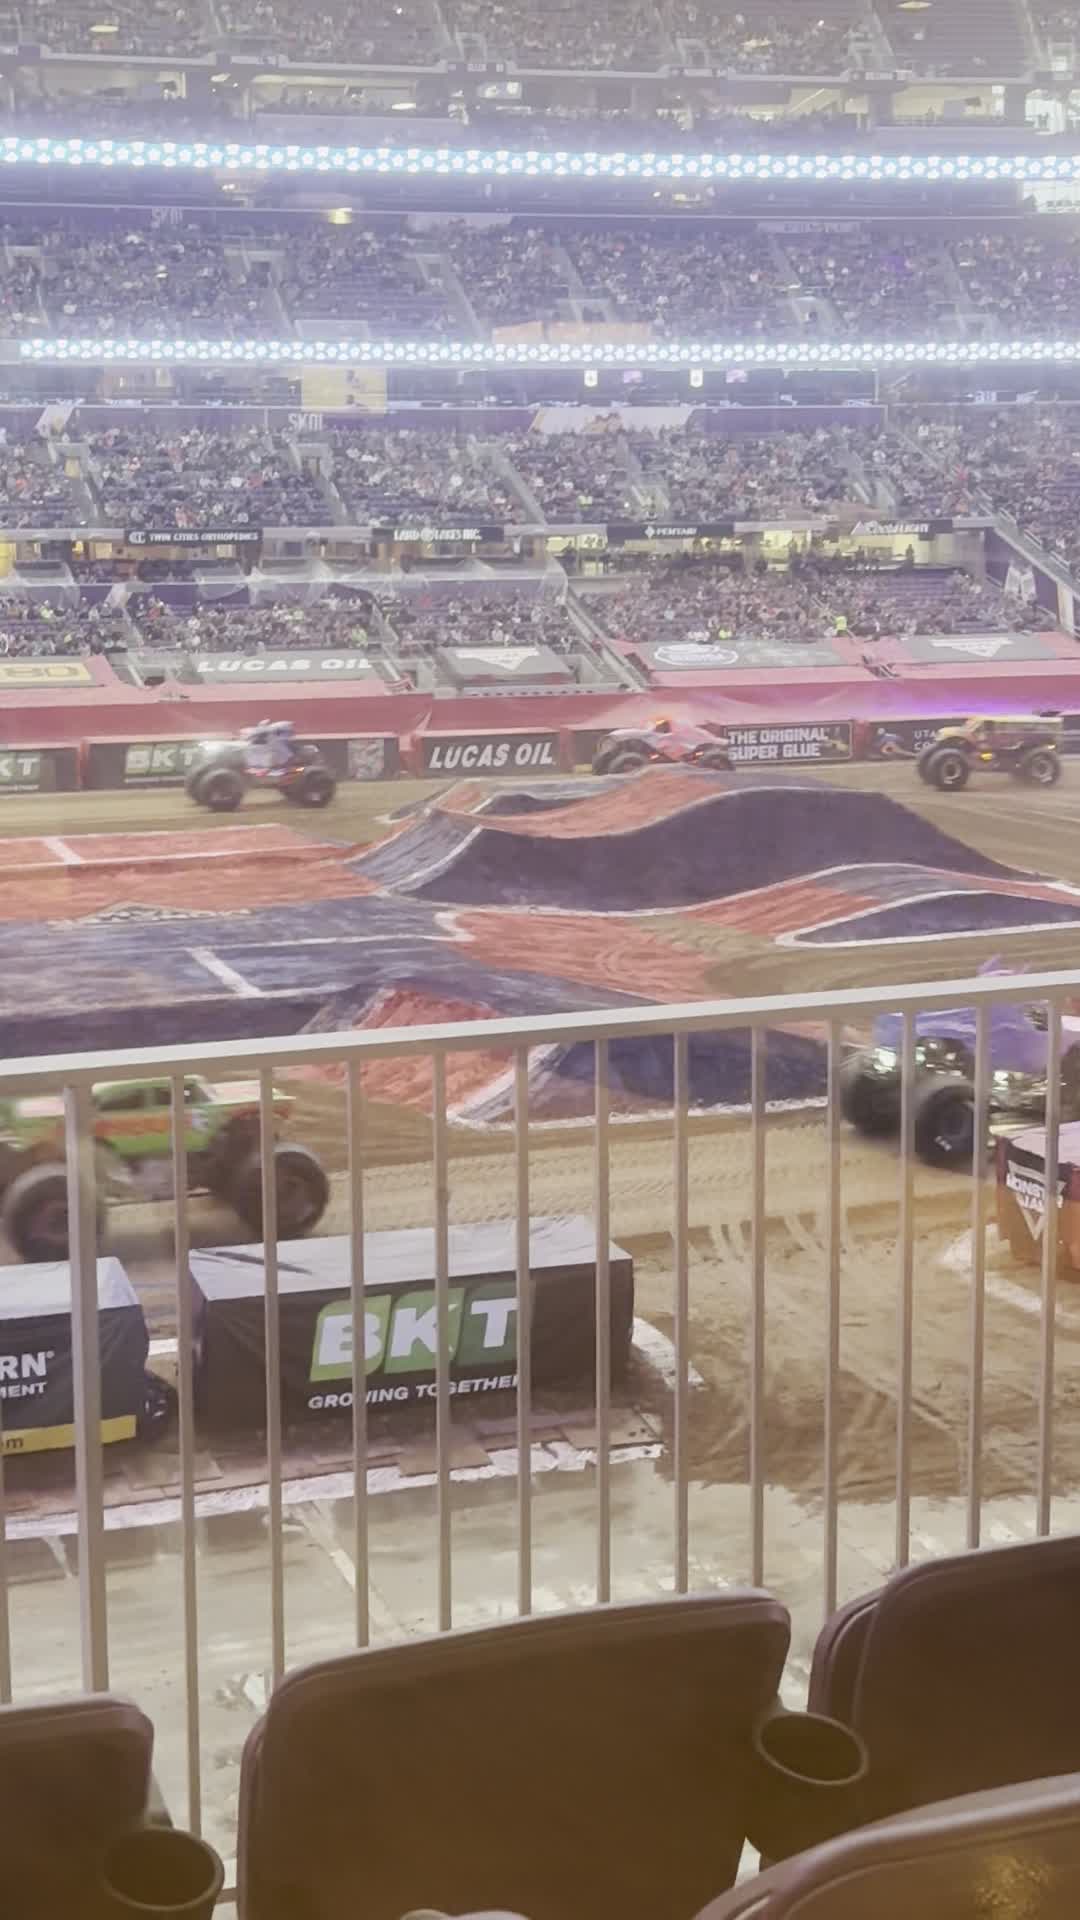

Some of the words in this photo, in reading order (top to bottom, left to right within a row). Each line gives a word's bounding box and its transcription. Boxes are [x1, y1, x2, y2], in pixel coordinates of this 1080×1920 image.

[150, 533, 171, 541] TWIN
[173, 532, 199, 541] CITIES
[201, 531, 258, 541] ORTHOPEDICS
[394, 529, 419, 541] LAND
[463, 528, 482, 540] INC.
[656, 528, 697, 536] PENTAIR
[197, 659, 312, 672] LUCAS
[321, 658, 372, 670] OIL
[728, 730, 758, 745] THE
[760, 727, 828, 743] ORIGINAL
[914, 729, 937, 739] UTA
[126, 748, 199, 769] BKT
[428, 743, 510, 769] LUCAS
[515, 742, 552, 765] OIL
[728, 744, 779, 761] SUPER
[782, 742, 821, 758] GLUE
[319, 1298, 519, 1366] BKT
[0, 1351, 47, 1381] RN
